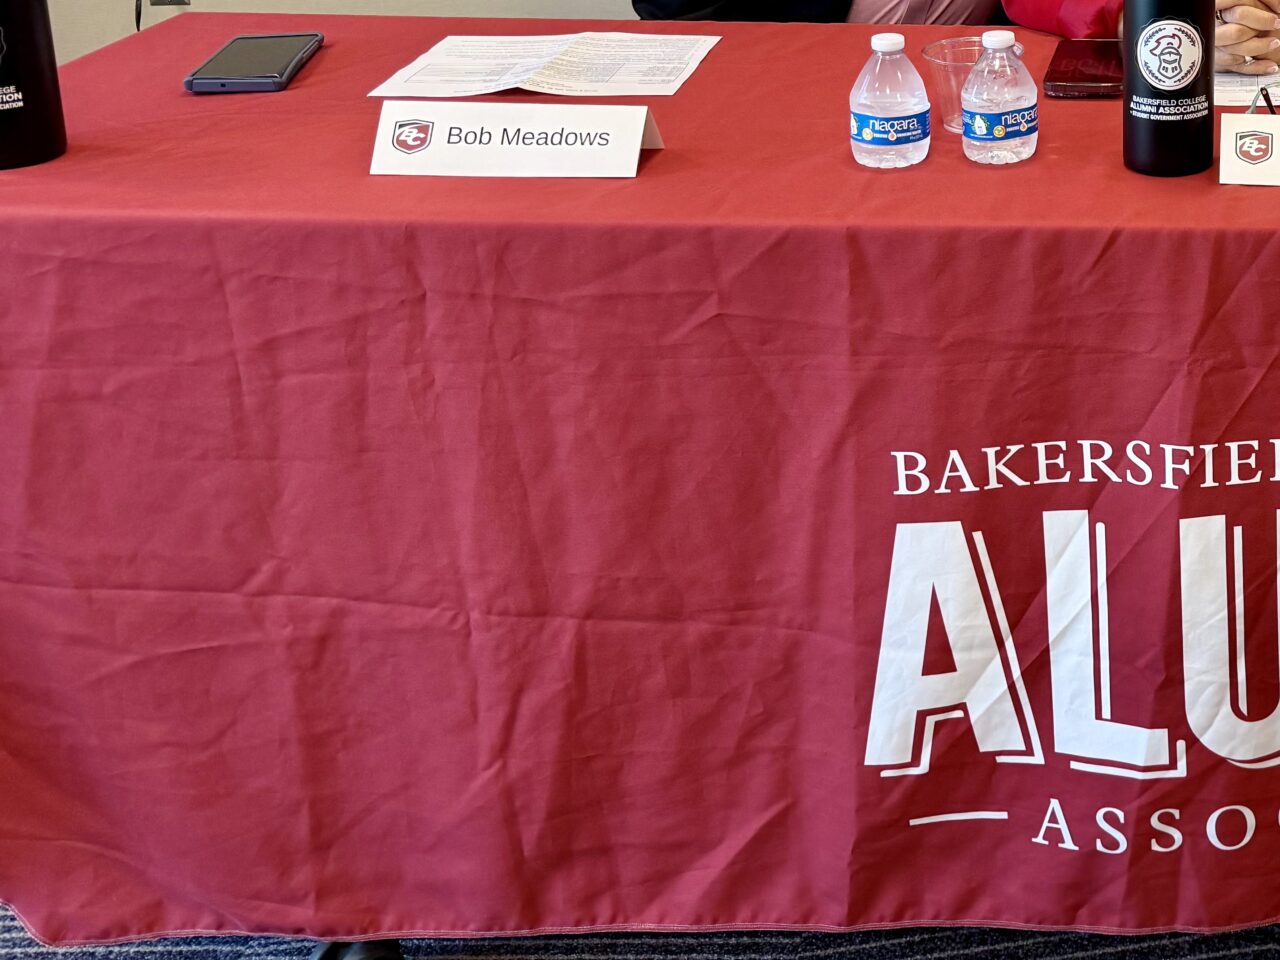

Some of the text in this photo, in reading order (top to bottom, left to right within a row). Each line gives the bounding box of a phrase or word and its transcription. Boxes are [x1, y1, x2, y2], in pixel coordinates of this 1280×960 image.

[1132, 95, 1206, 106] BAKERSFIELD COLLEGE
[1130, 101, 1208, 114] ALUMNI ASSOCIATION
[870, 118, 917, 132] niagara
[446, 127, 610, 147] Bob Meadows
